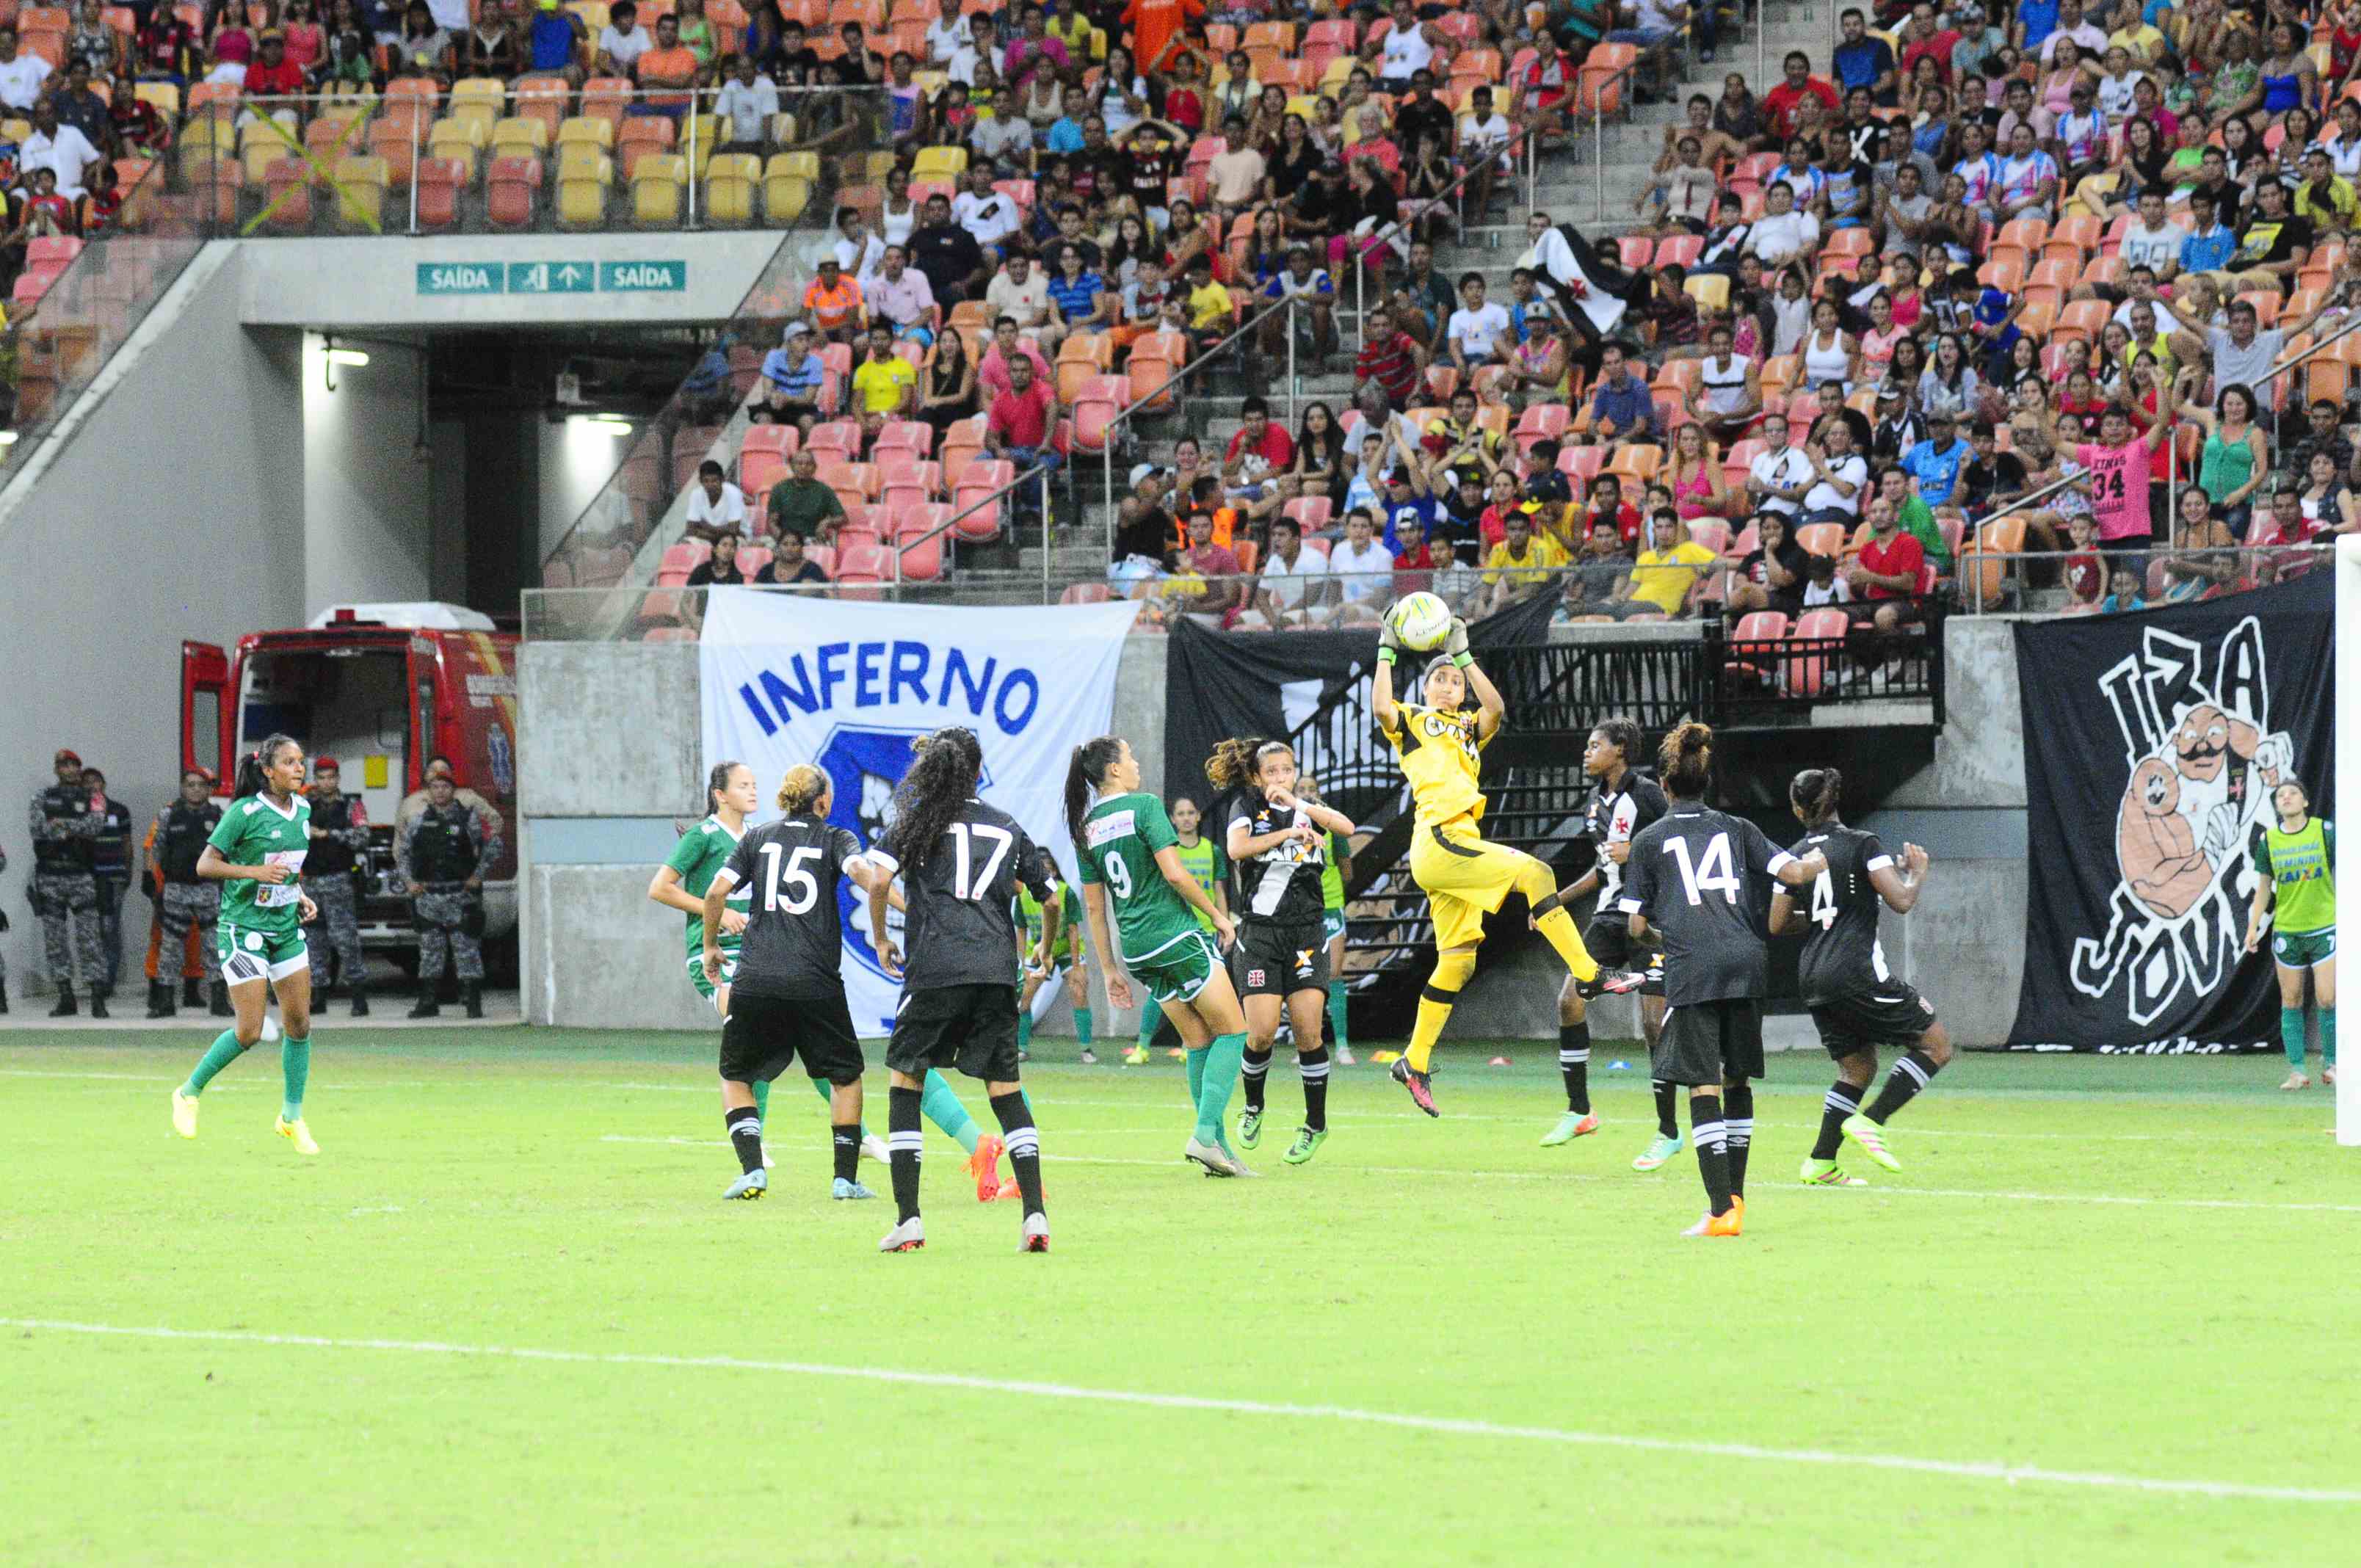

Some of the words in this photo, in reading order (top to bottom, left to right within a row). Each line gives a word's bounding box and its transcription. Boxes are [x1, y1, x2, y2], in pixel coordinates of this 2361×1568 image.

[431, 264, 490, 289] SAÍDA
[614, 264, 672, 288] SAÍDA
[2093, 469, 2125, 501] 34
[739, 640, 1040, 737] INFERNO
[758, 841, 823, 915] 15
[947, 822, 1013, 901] 17
[1103, 850, 1132, 899] 9
[1662, 832, 1741, 906] 14
[1811, 869, 1838, 931] 4
